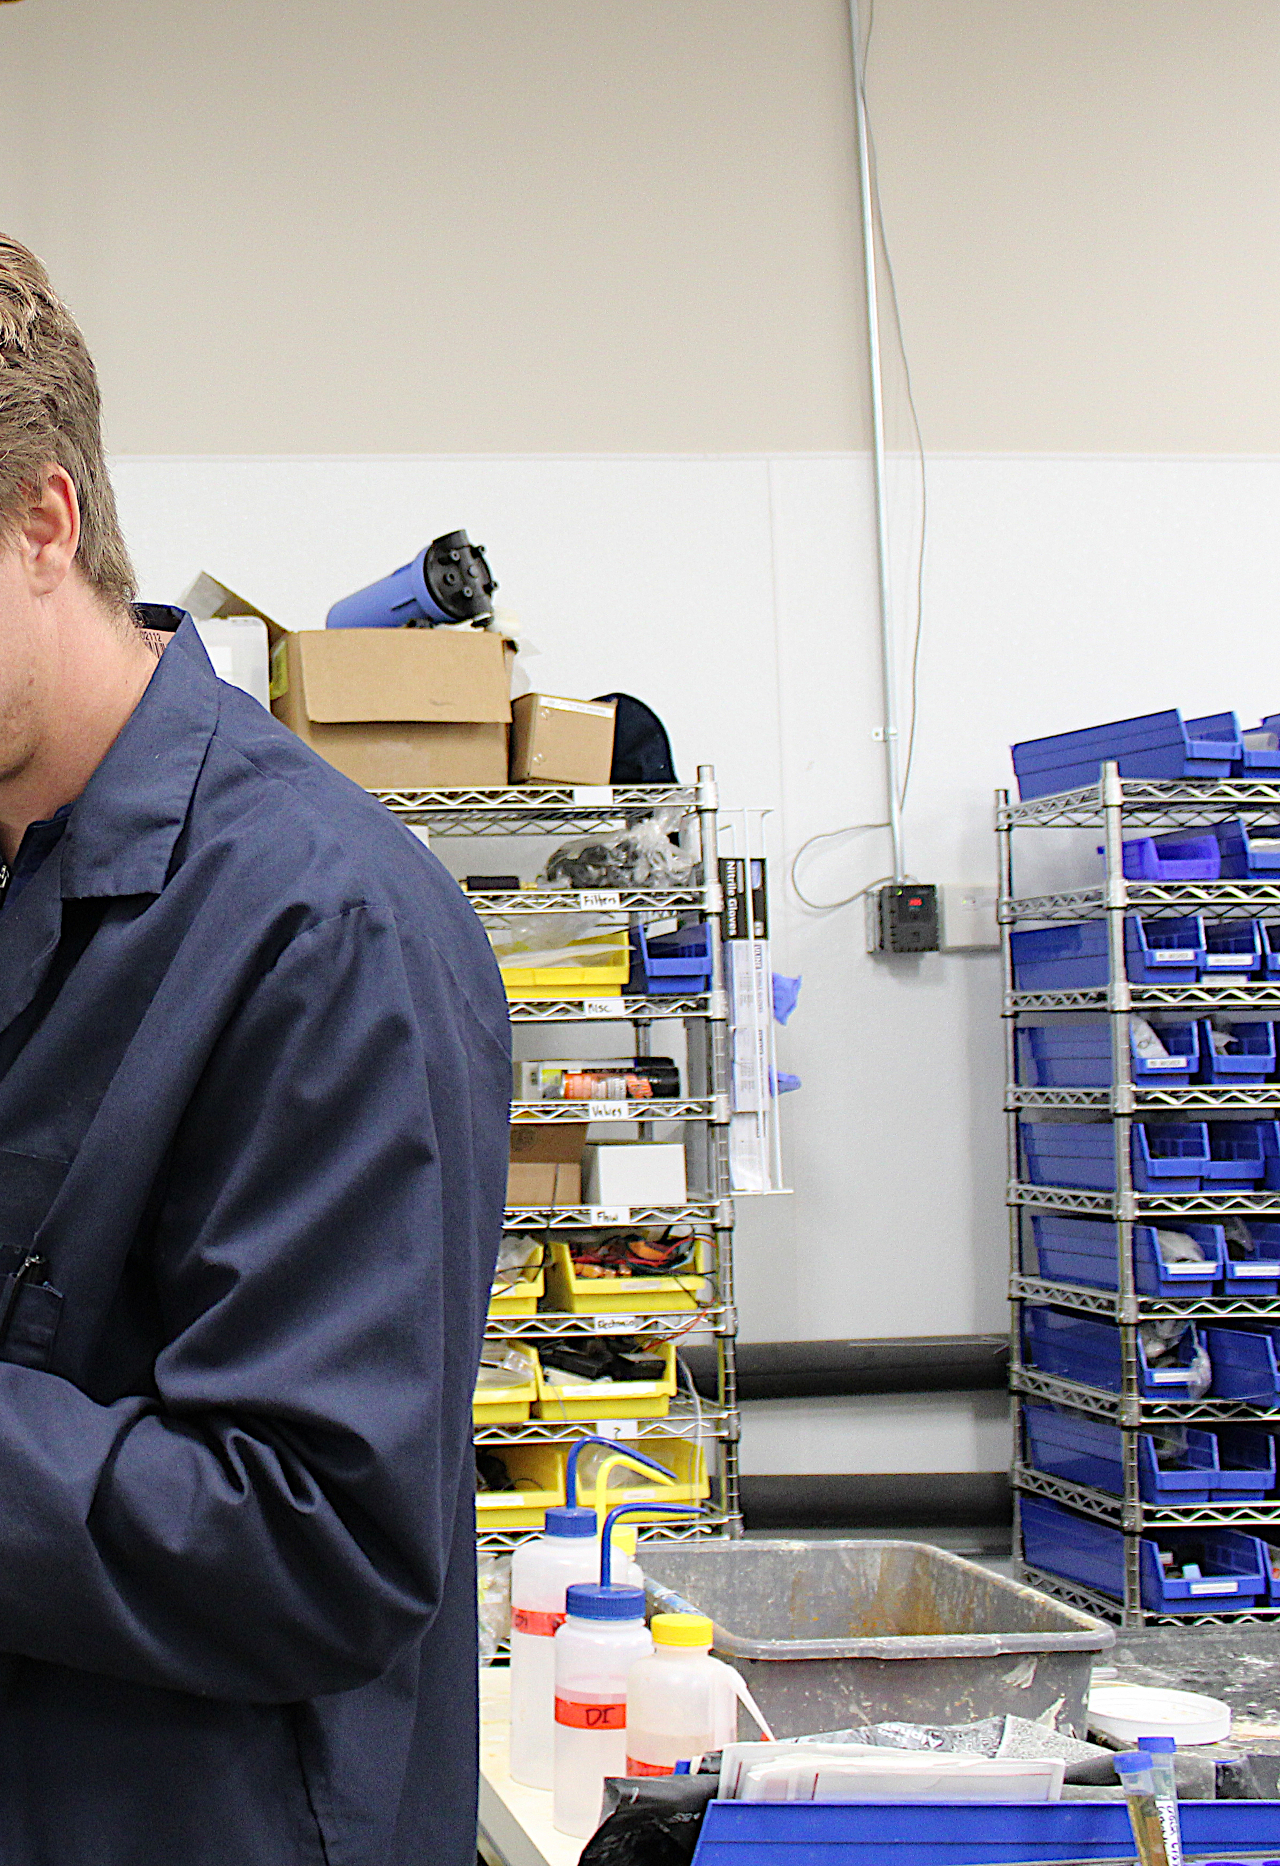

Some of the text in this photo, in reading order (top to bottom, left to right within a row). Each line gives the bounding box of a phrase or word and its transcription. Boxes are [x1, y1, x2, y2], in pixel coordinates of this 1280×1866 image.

[726, 861, 739, 936] Nitrile Gloves
[585, 1707, 616, 1726] DI
